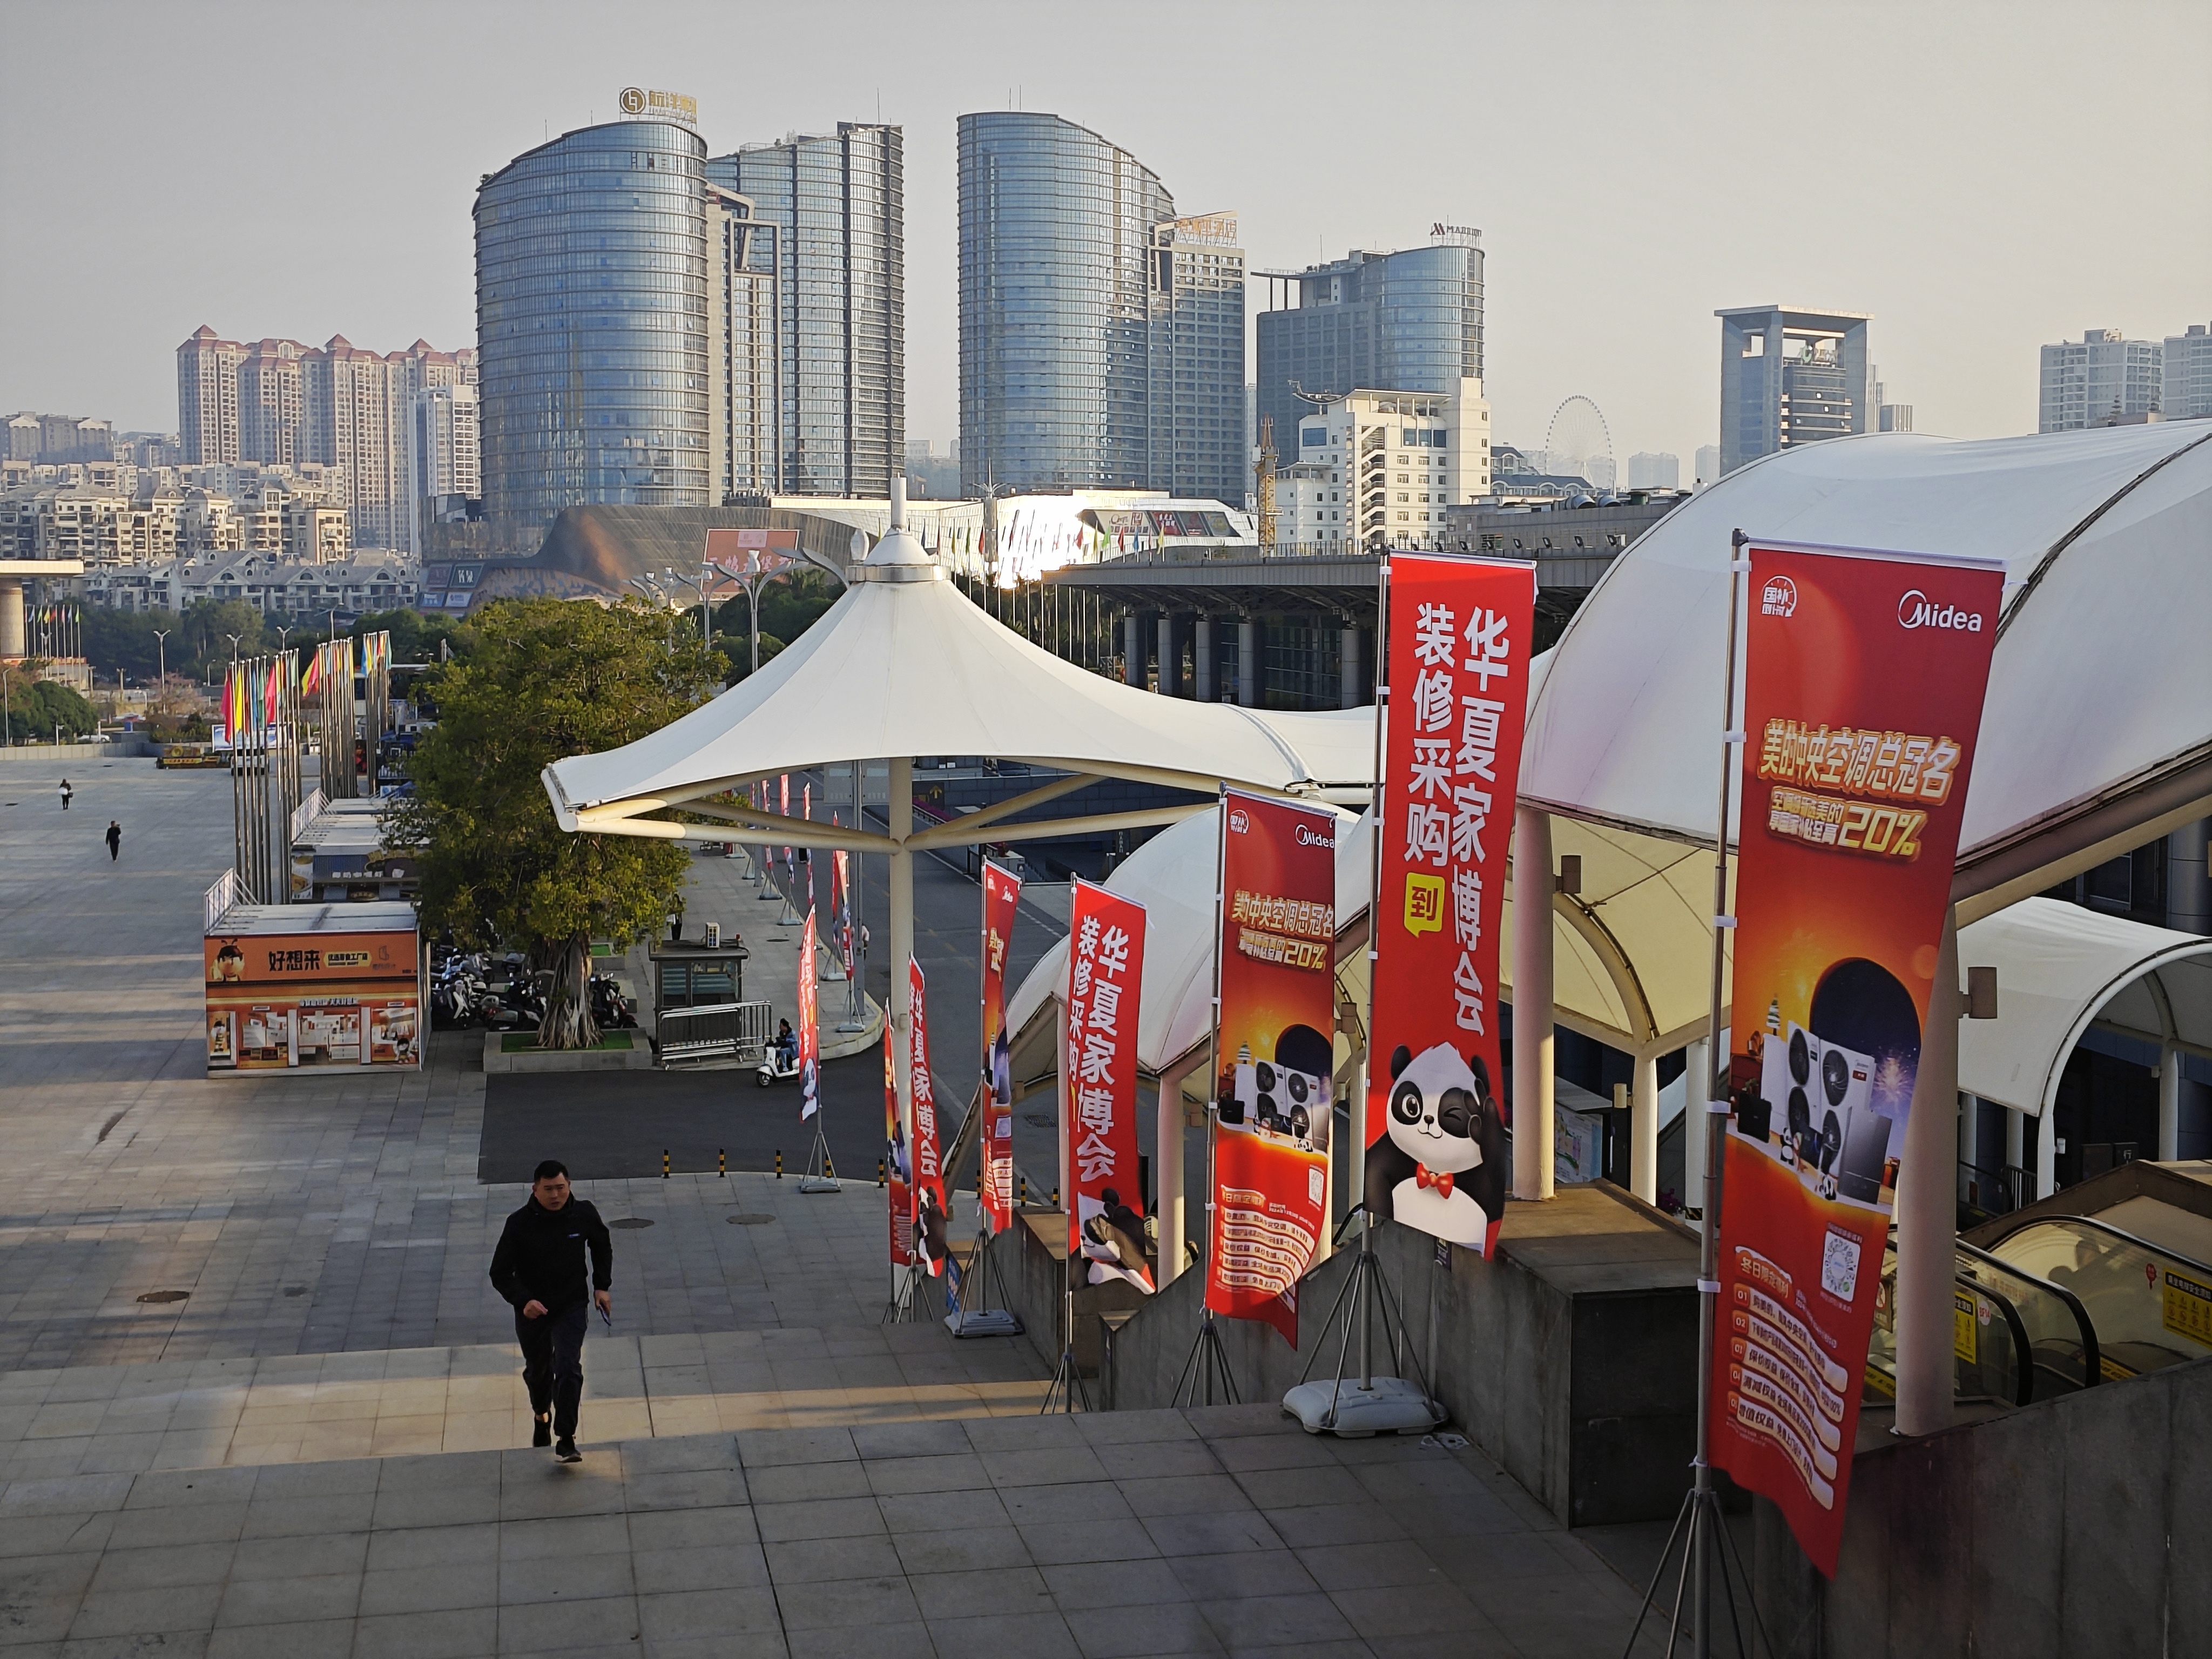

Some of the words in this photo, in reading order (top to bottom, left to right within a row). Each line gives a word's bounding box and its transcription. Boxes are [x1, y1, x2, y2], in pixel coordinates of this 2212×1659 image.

[1898, 589, 1982, 632] Midea
[1404, 602, 1455, 867] 装修采购
[1759, 719, 1960, 801] 美的中央空调总冠名
[1296, 824, 1335, 848] Midea
[1452, 606, 1509, 1036] 华夏家博会
[1837, 806, 1923, 856] 20%
[1410, 886, 1439, 921] 到
[268, 949, 320, 972] 好想来
[1284, 941, 1325, 969] 20%
[1077, 925, 1130, 1182] 华夏家博会
[1737, 1287, 1748, 1300] 01
[1736, 1317, 1746, 1328] 02
